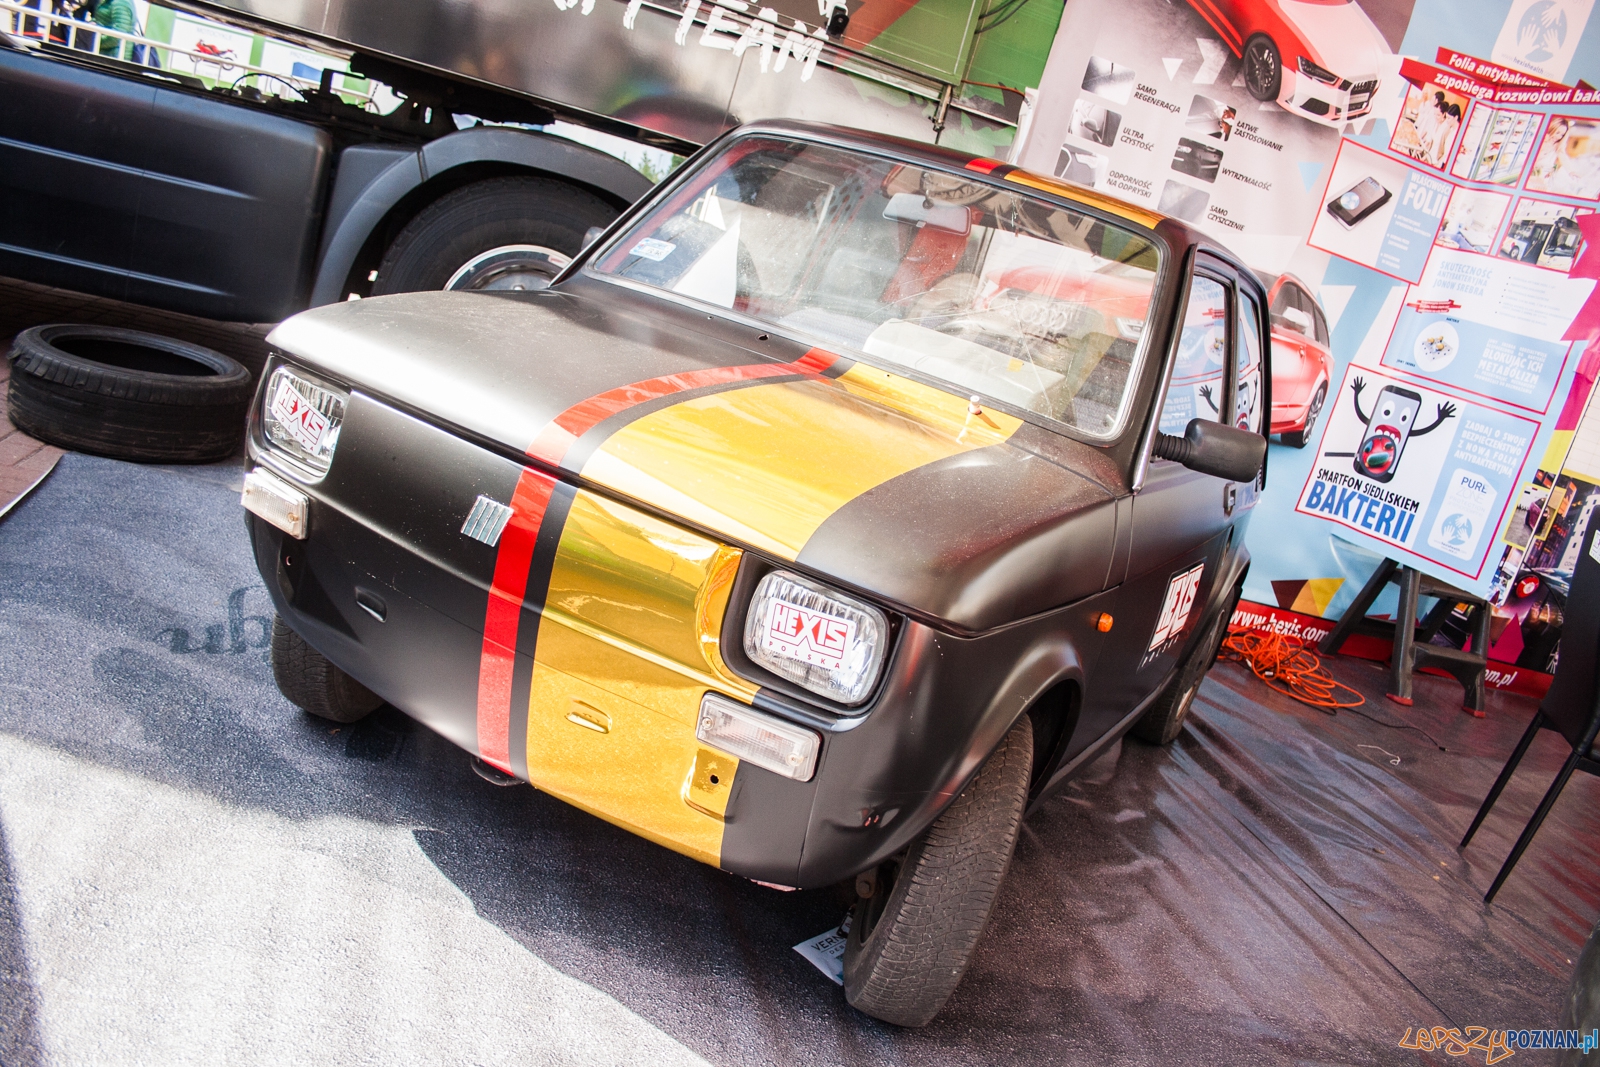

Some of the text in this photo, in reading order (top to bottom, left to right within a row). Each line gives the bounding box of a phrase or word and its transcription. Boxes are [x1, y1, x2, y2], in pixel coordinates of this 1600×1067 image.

[1449, 53, 1475, 72] Folia
[1135, 83, 1157, 96] SAMO
[1434, 73, 1494, 99] zapobiega
[1495, 89, 1573, 105] rozwojowi
[1133, 91, 1181, 114] REGENERACJA
[1122, 126, 1144, 140] ULTRA
[1236, 120, 1259, 134] ŁATWE
[1120, 136, 1154, 152] CZYSTOŚĆ
[1234, 128, 1283, 152] ZASTOSOWANIE
[1106, 177, 1152, 199] NA ODPRYSKI
[1109, 170, 1153, 190] ODPORNOŚĆ
[1221, 167, 1272, 191] WYTRZYMAŁOŚĆ
[1209, 204, 1229, 217] SAMO
[1402, 182, 1448, 219] FOLII
[1207, 213, 1246, 232] CZYSZCZENIE
[1437, 270, 1488, 287] ANTYBAKTERYJNA
[1440, 260, 1493, 279] SKUTECZNOŚĆ
[1456, 283, 1484, 297] SREBRA
[1478, 359, 1540, 385] METABOLIZM
[1482, 347, 1527, 369] BLOKUJĄC
[1527, 360, 1544, 373] ICH
[277, 384, 326, 446] HEXIS
[274, 409, 315, 452] POLSKA
[1464, 420, 1527, 447] ZADBAJ O SWOJE
[1457, 439, 1518, 468] Z NOWĄ FOLIĄ
[1461, 430, 1522, 456] BEZPIECZEŃSTWO
[1454, 450, 1514, 478] ANTYBAKTERYJNĄ
[1316, 468, 1363, 491] SMARTFON
[1363, 483, 1420, 513] SIEDLISKIEM
[1460, 476, 1488, 494] PURE
[1305, 480, 1416, 543] BAKTERII
[1148, 563, 1204, 652] HEXIS
[770, 603, 849, 659] HEXIS
[769, 641, 840, 669] POLSKA
